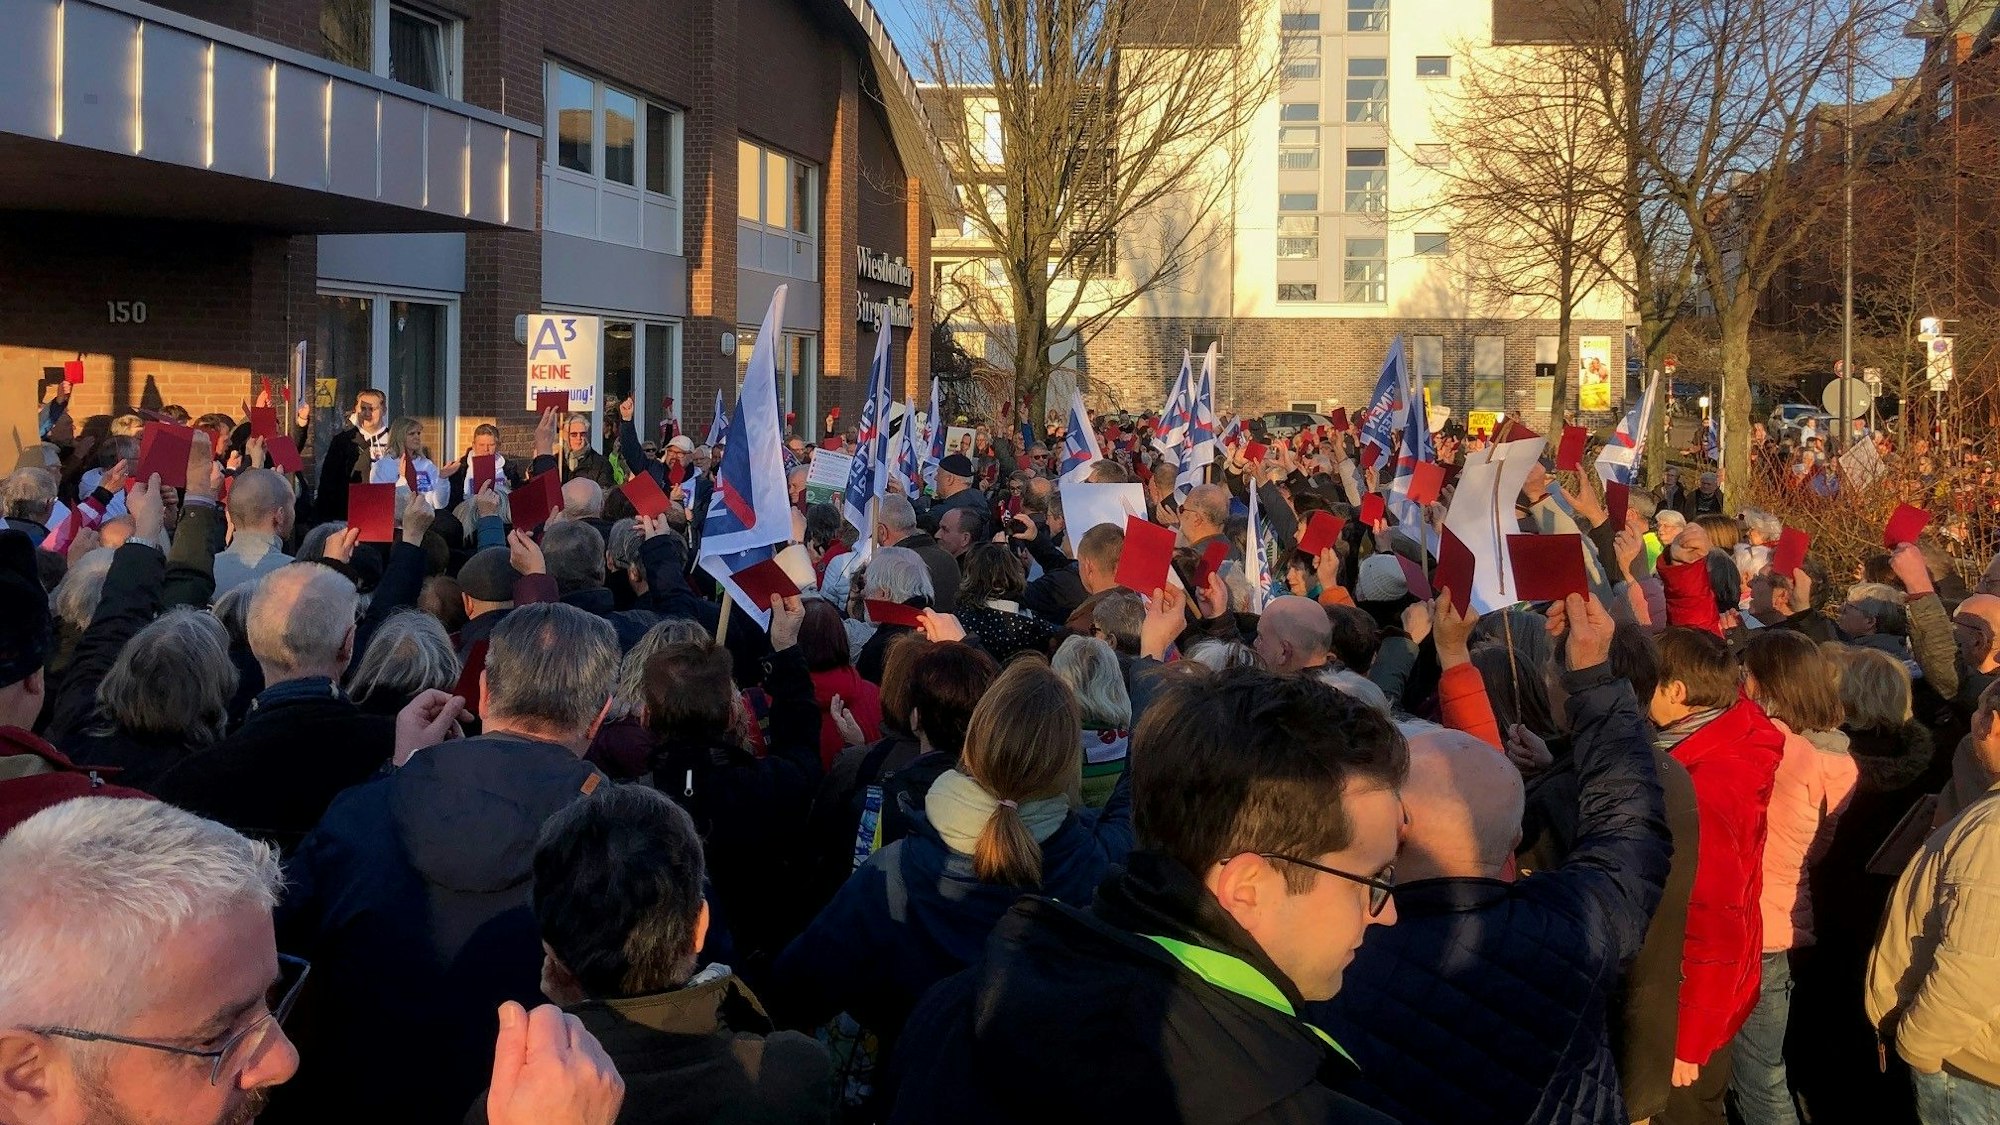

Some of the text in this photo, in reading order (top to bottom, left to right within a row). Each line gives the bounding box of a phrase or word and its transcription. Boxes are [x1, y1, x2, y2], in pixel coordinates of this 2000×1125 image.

[856, 245, 913, 288] Wiesdorfer
[107, 300, 147, 323] 150
[531, 364, 571, 380] KEINE
